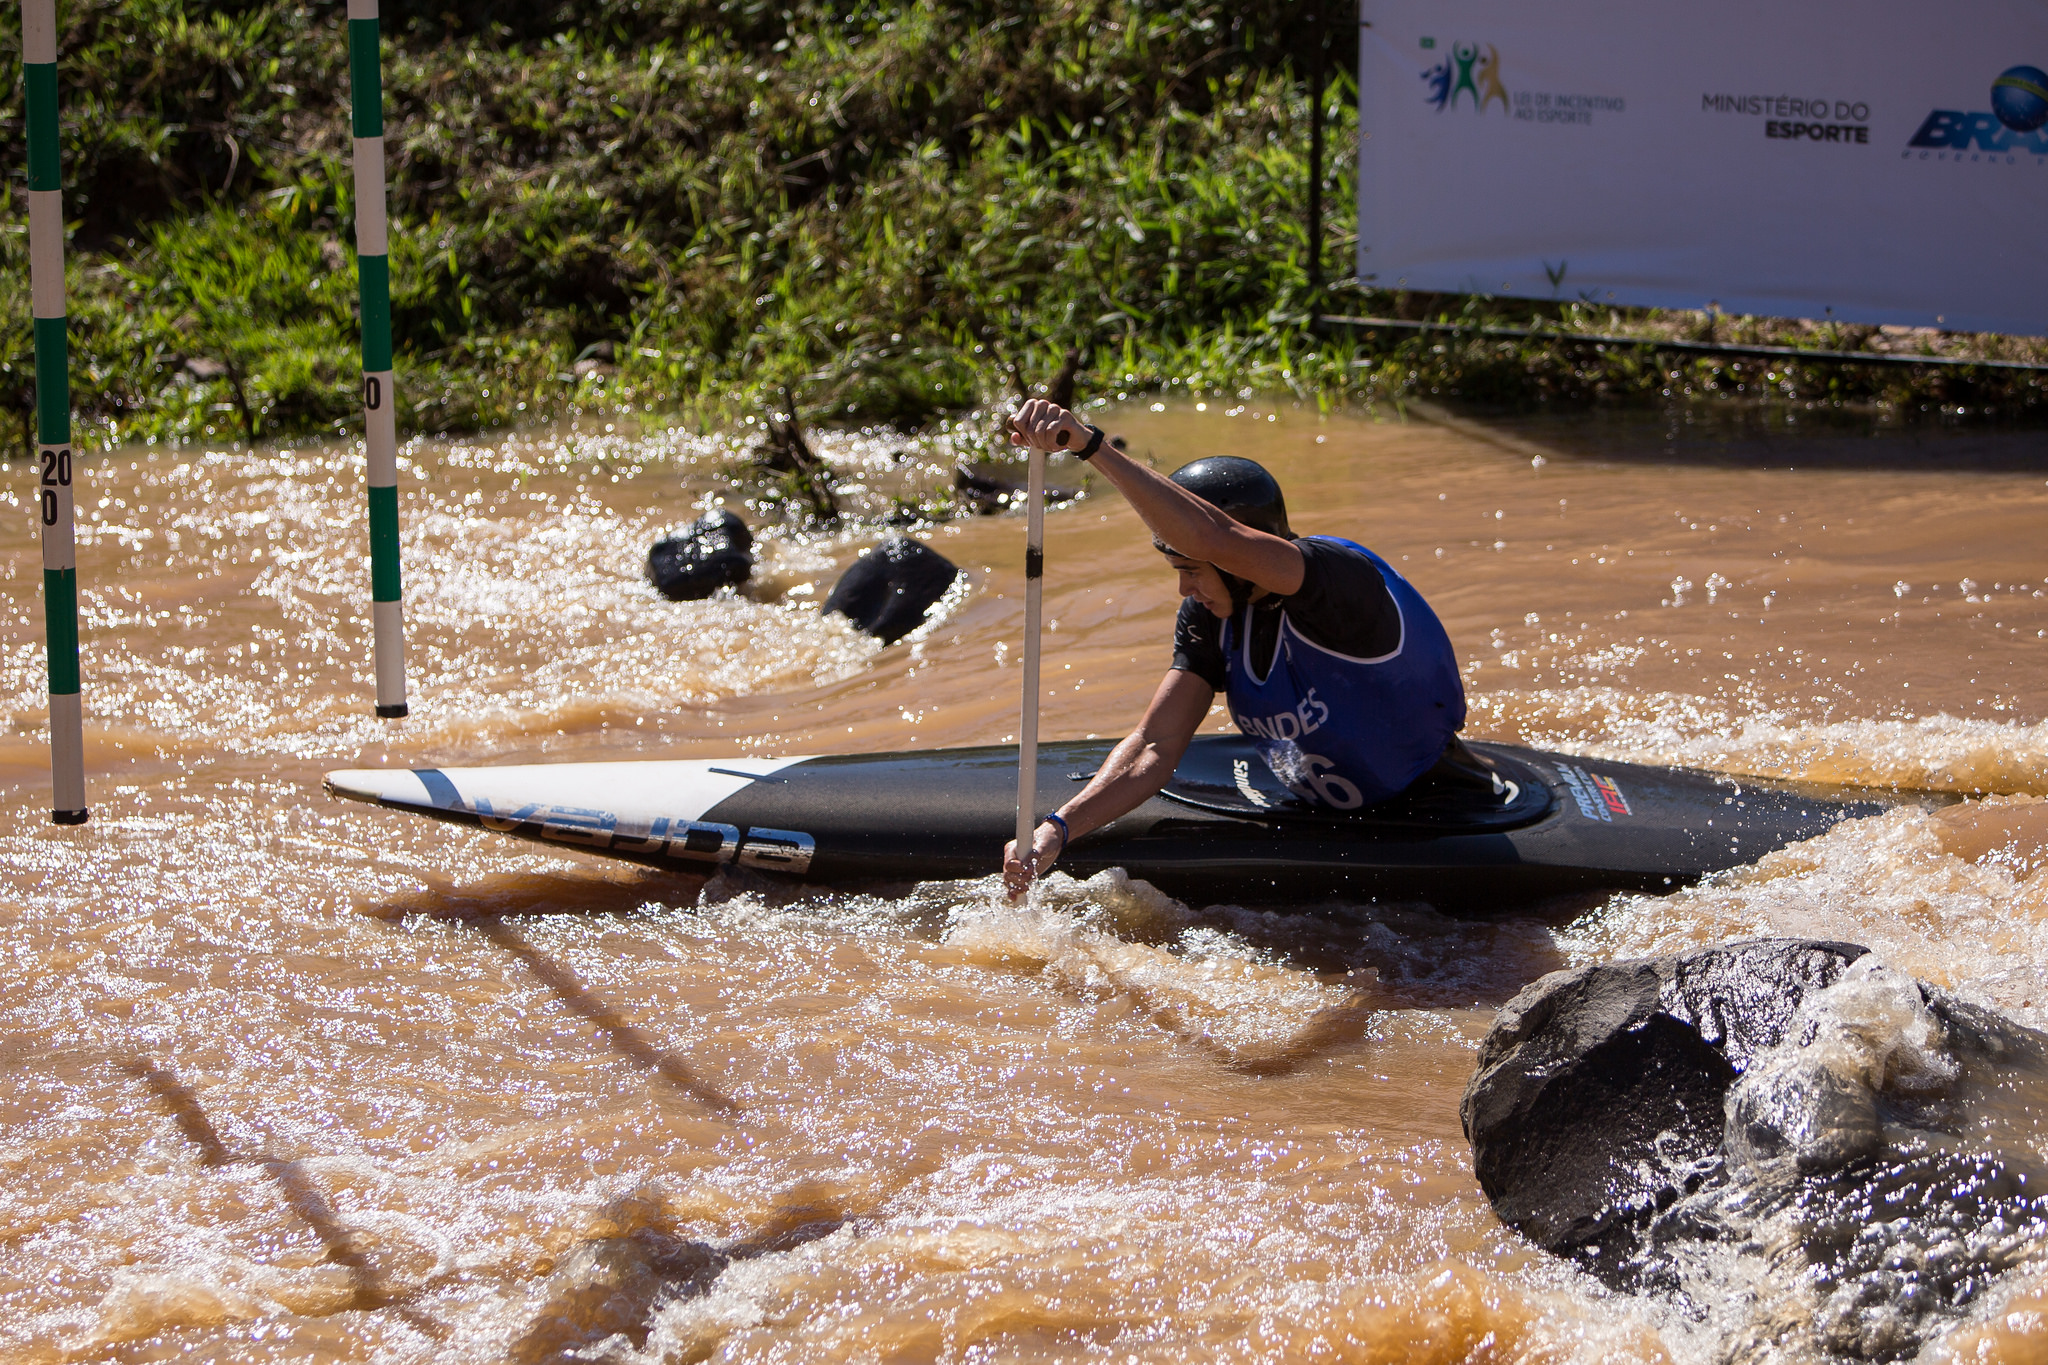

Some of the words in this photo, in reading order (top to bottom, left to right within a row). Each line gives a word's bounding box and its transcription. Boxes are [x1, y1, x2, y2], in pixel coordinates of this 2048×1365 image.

[1701, 93, 1828, 119] MINISTÉRIO
[1835, 102, 1870, 121] DO
[1765, 121, 1869, 144] ESPORTE
[1907, 109, 2048, 155] BRA
[41, 449, 71, 496] 20
[1237, 687, 1329, 741] BNDES
